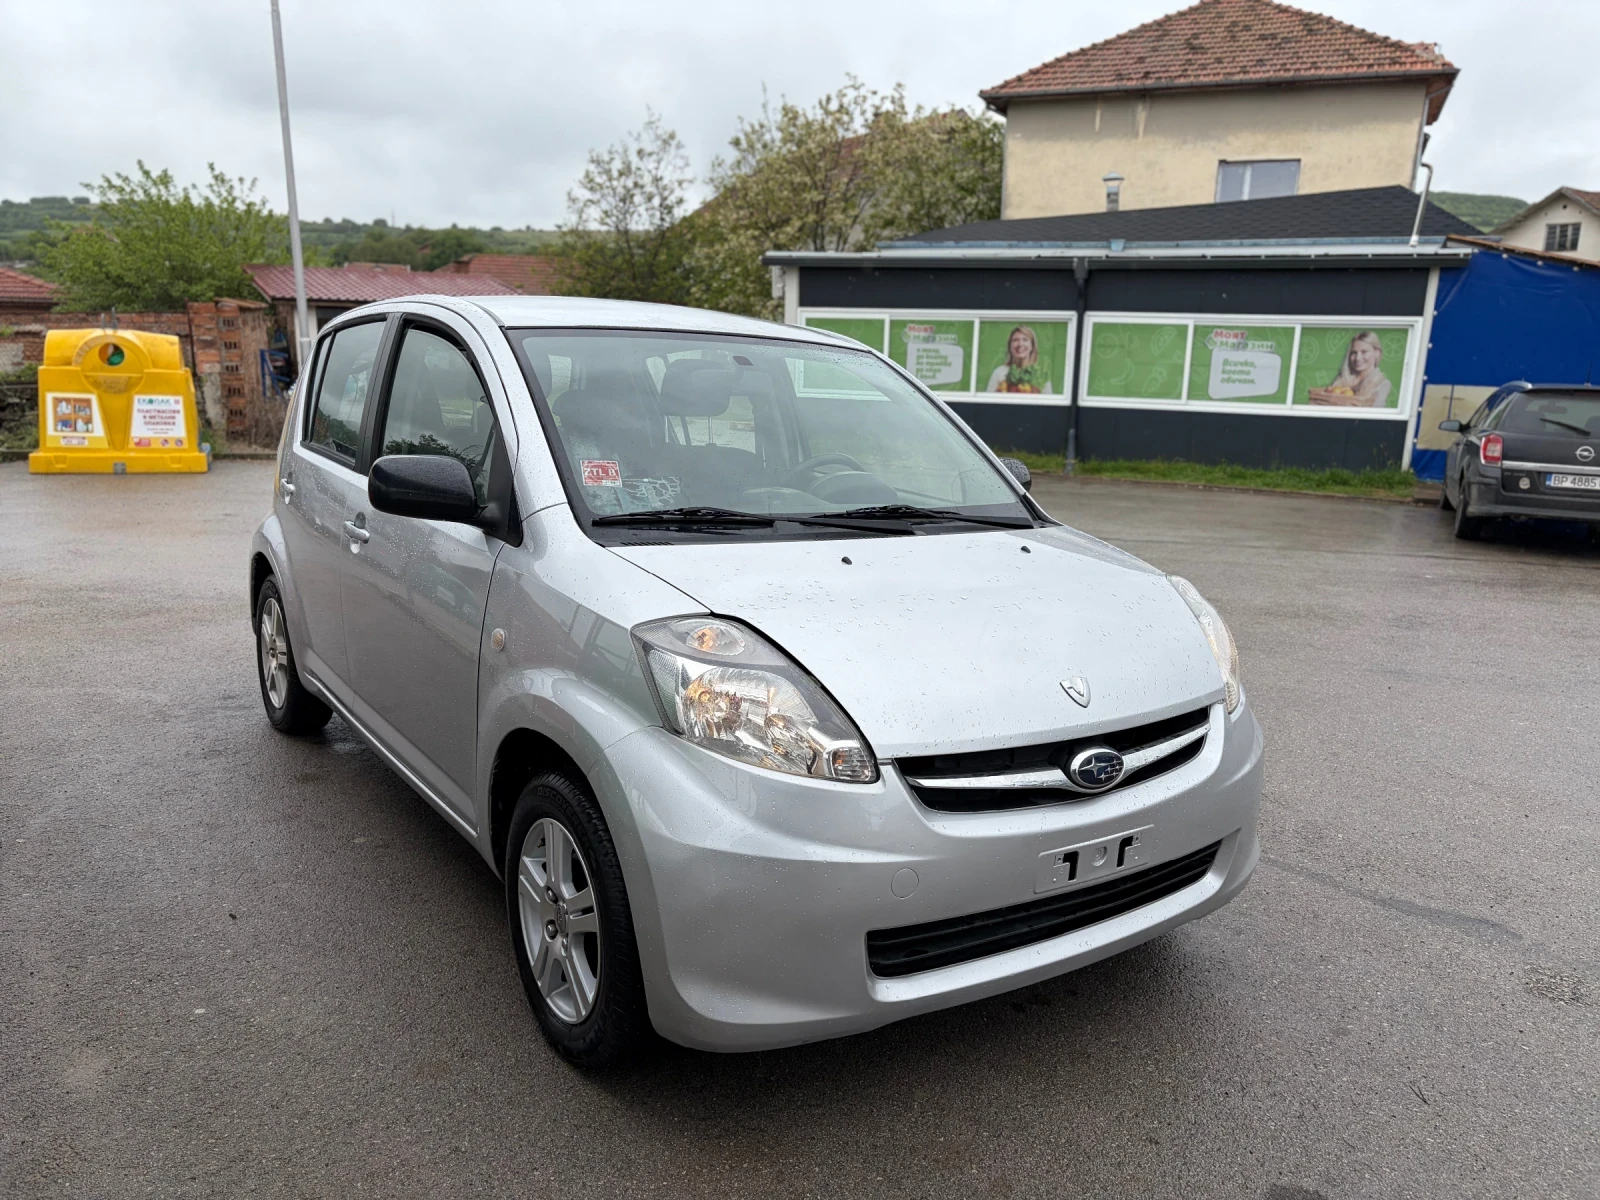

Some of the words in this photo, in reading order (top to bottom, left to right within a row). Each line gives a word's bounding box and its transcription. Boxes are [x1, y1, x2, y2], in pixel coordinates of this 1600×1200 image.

[1213, 330, 1247, 339] Моят
[1219, 340, 1274, 350] Магазин
[584, 468, 606, 476] ZTL
[1570, 476, 1597, 488] 4885
